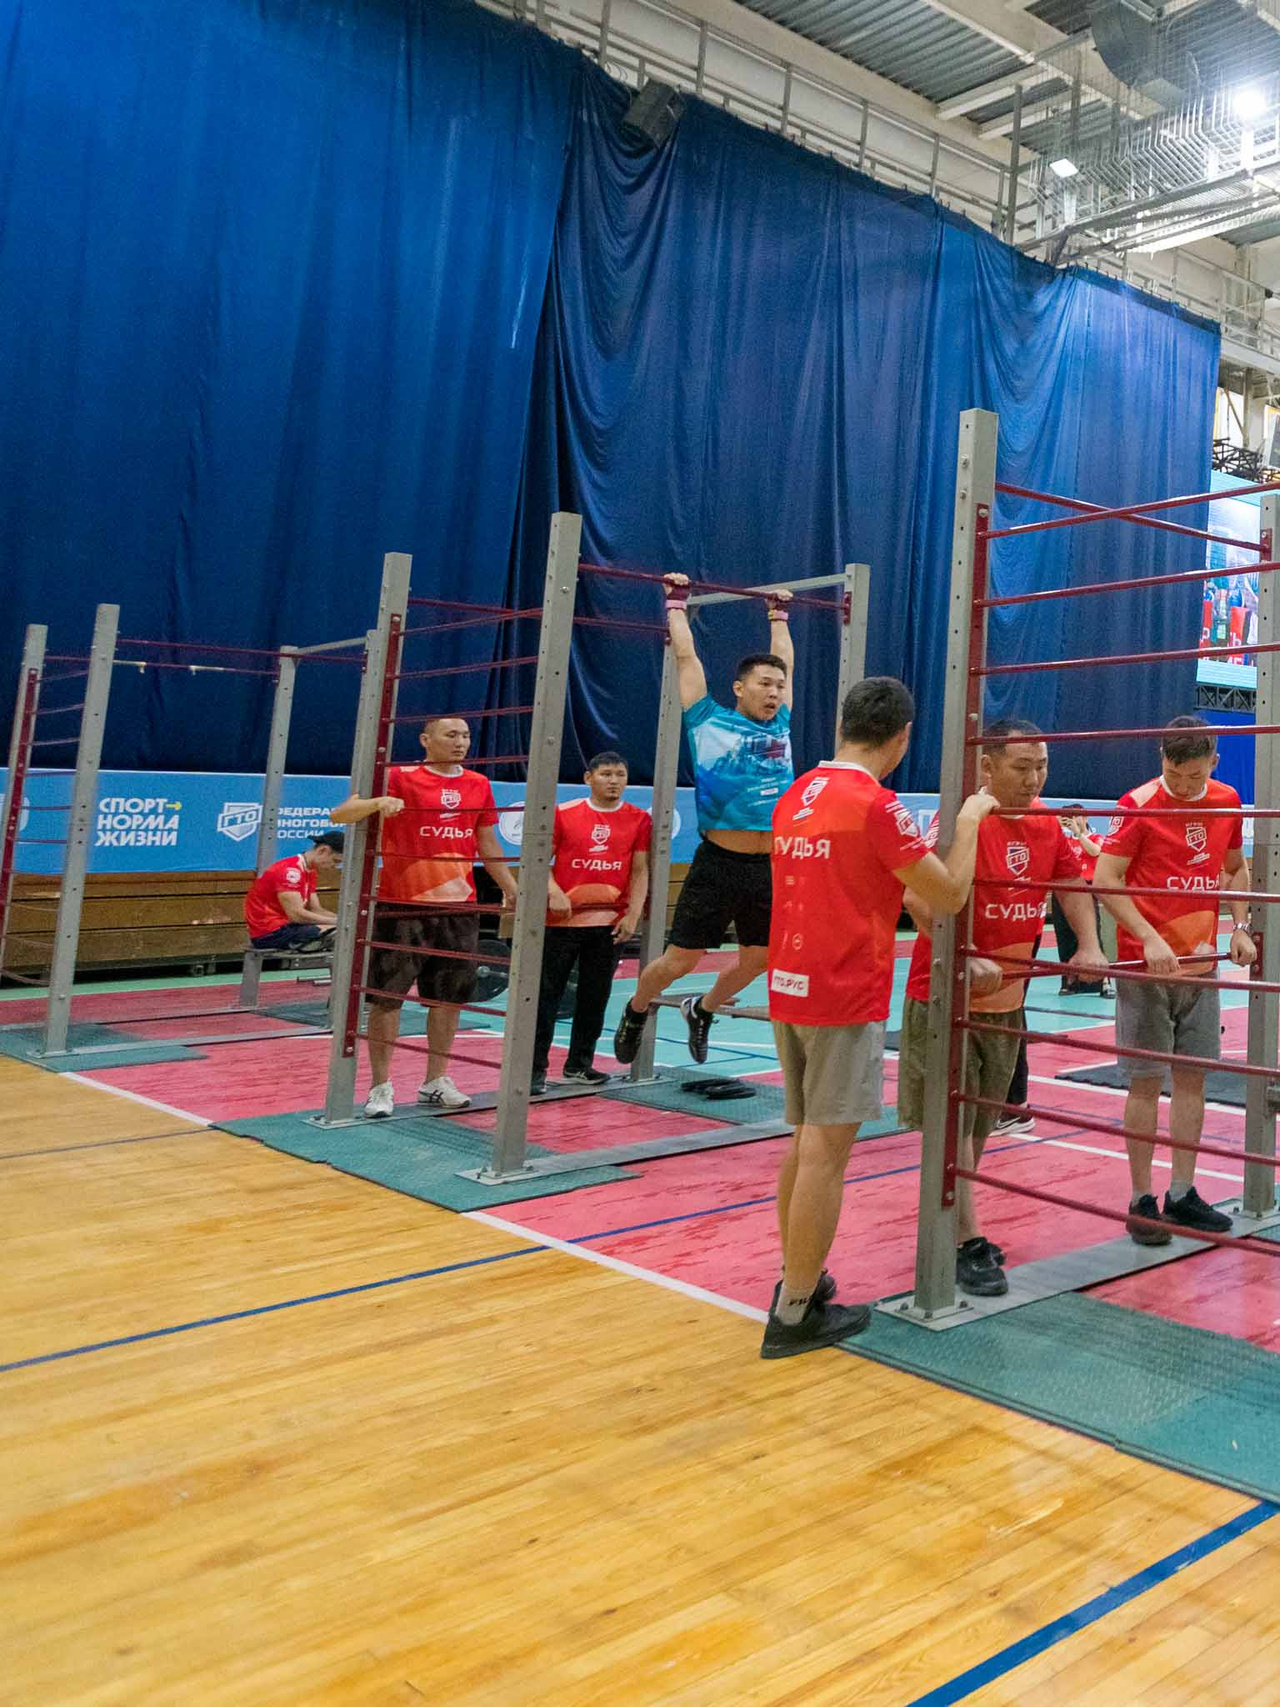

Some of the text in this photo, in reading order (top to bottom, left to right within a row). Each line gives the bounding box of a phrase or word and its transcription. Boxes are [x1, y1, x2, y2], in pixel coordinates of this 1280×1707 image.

[99, 797, 167, 813] СПОРТ
[97, 814, 180, 830] НОРМА
[223, 811, 257, 827] ГТО
[94, 831, 178, 846] ЖИЗНИ
[420, 826, 474, 839] СУДЬЯ
[571, 858, 622, 871] СУДЬЯ
